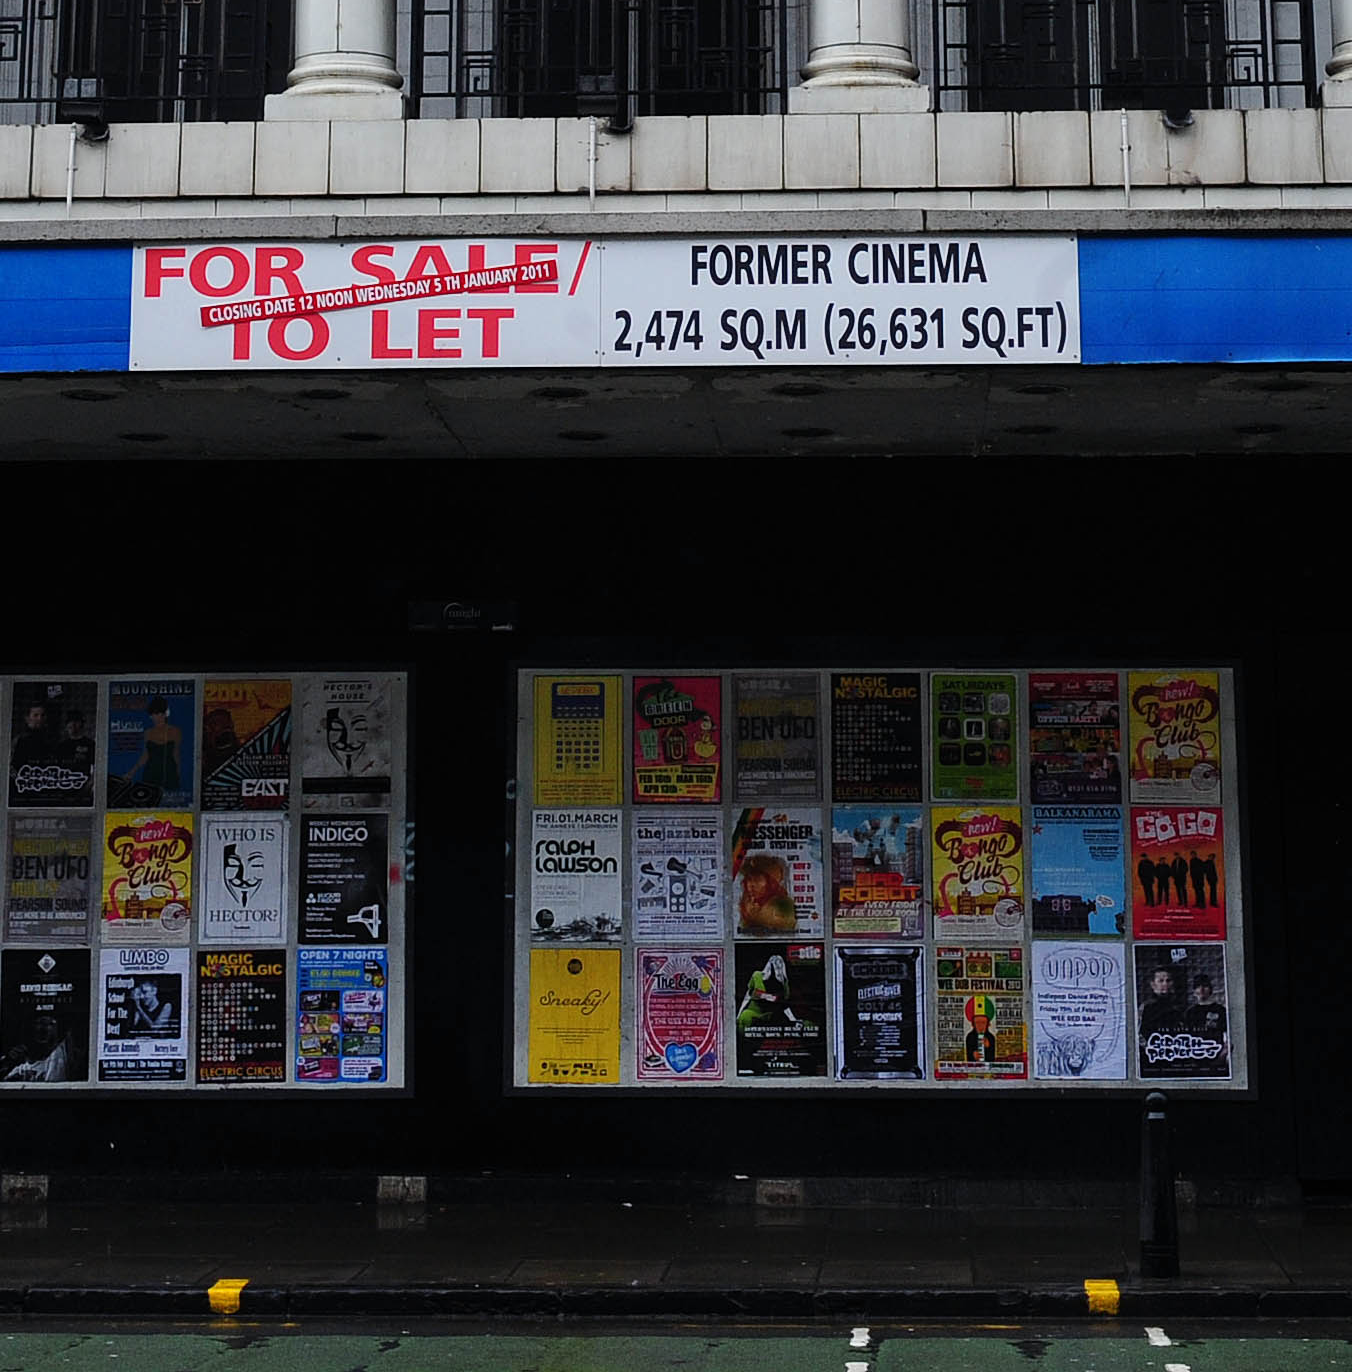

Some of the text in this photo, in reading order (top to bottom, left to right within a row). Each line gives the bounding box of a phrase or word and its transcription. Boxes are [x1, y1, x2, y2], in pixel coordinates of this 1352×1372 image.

[144, 246, 305, 299] FOR
[691, 243, 987, 286] FORMER CINEMA
[209, 264, 550, 323] CLOSING DATE 12 NOON WEDNESDAY 5 TH JANUARY 2011
[371, 308, 515, 359] LET
[614, 301, 1067, 359] 2,474 SQ.M (26,631 SQ.FT)
[242, 779, 288, 796] EAST
[536, 813, 618, 823] FRI.01.MARCH
[216, 829, 275, 841] WHO IS
[308, 827, 369, 842] INDIGO
[14, 856, 88, 879] BEN UFO
[210, 910, 278, 922] HECTOR?
[120, 949, 169, 965] LIMBO
[206, 954, 254, 965] MAGIC
[300, 950, 384, 960] OPEN NIGHTS
[200, 1066, 284, 1077] ELECTRIC CIRCUS
